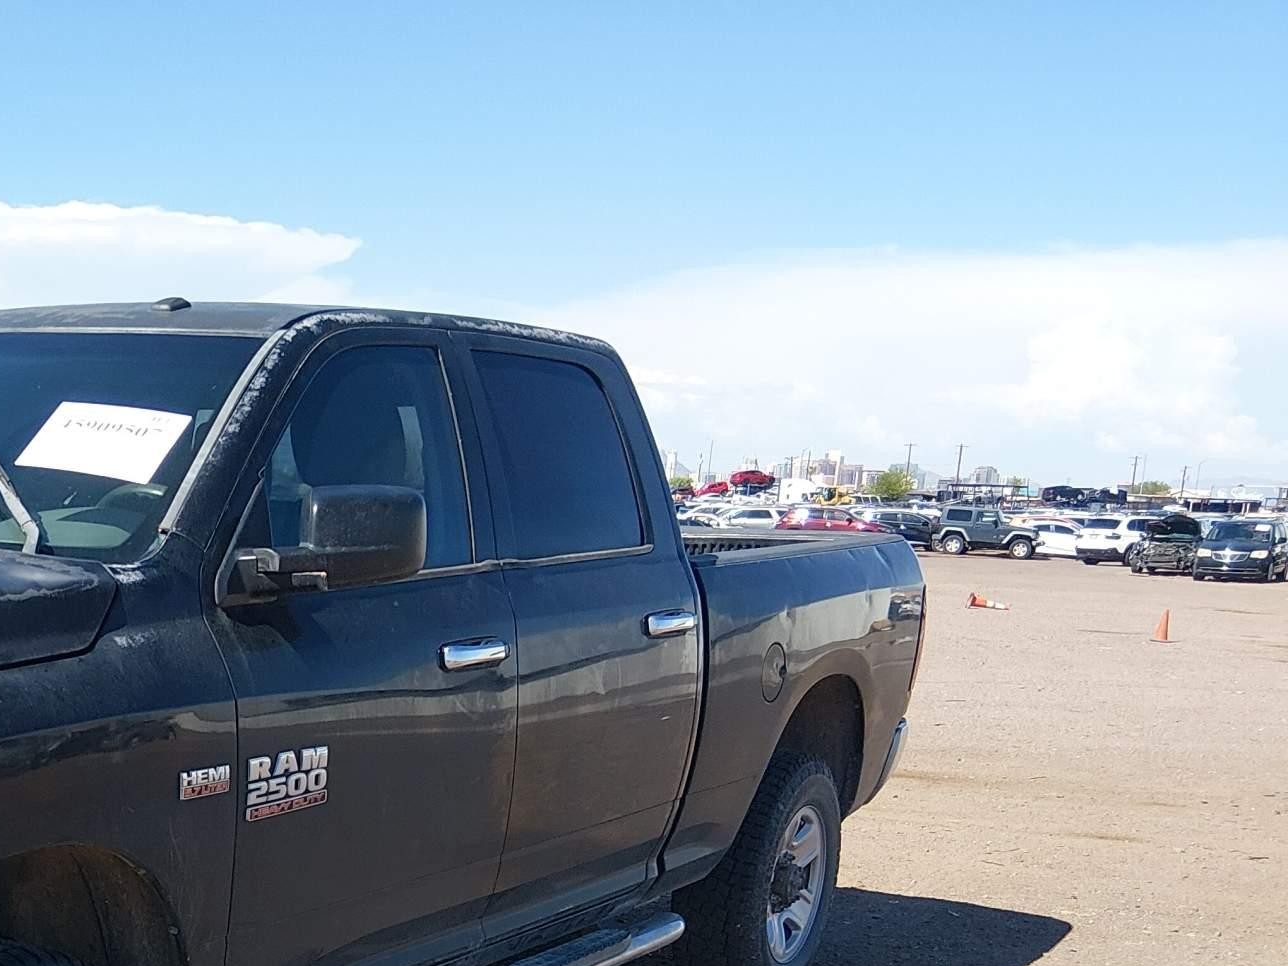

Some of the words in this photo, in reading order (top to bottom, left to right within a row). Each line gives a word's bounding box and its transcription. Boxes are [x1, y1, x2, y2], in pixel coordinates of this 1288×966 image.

[180, 765, 229, 787] HEMI
[248, 746, 328, 781] RAM
[247, 768, 327, 805] 2500
[251, 801, 292, 819] HEAVY
[292, 791, 325, 809] DUTY
